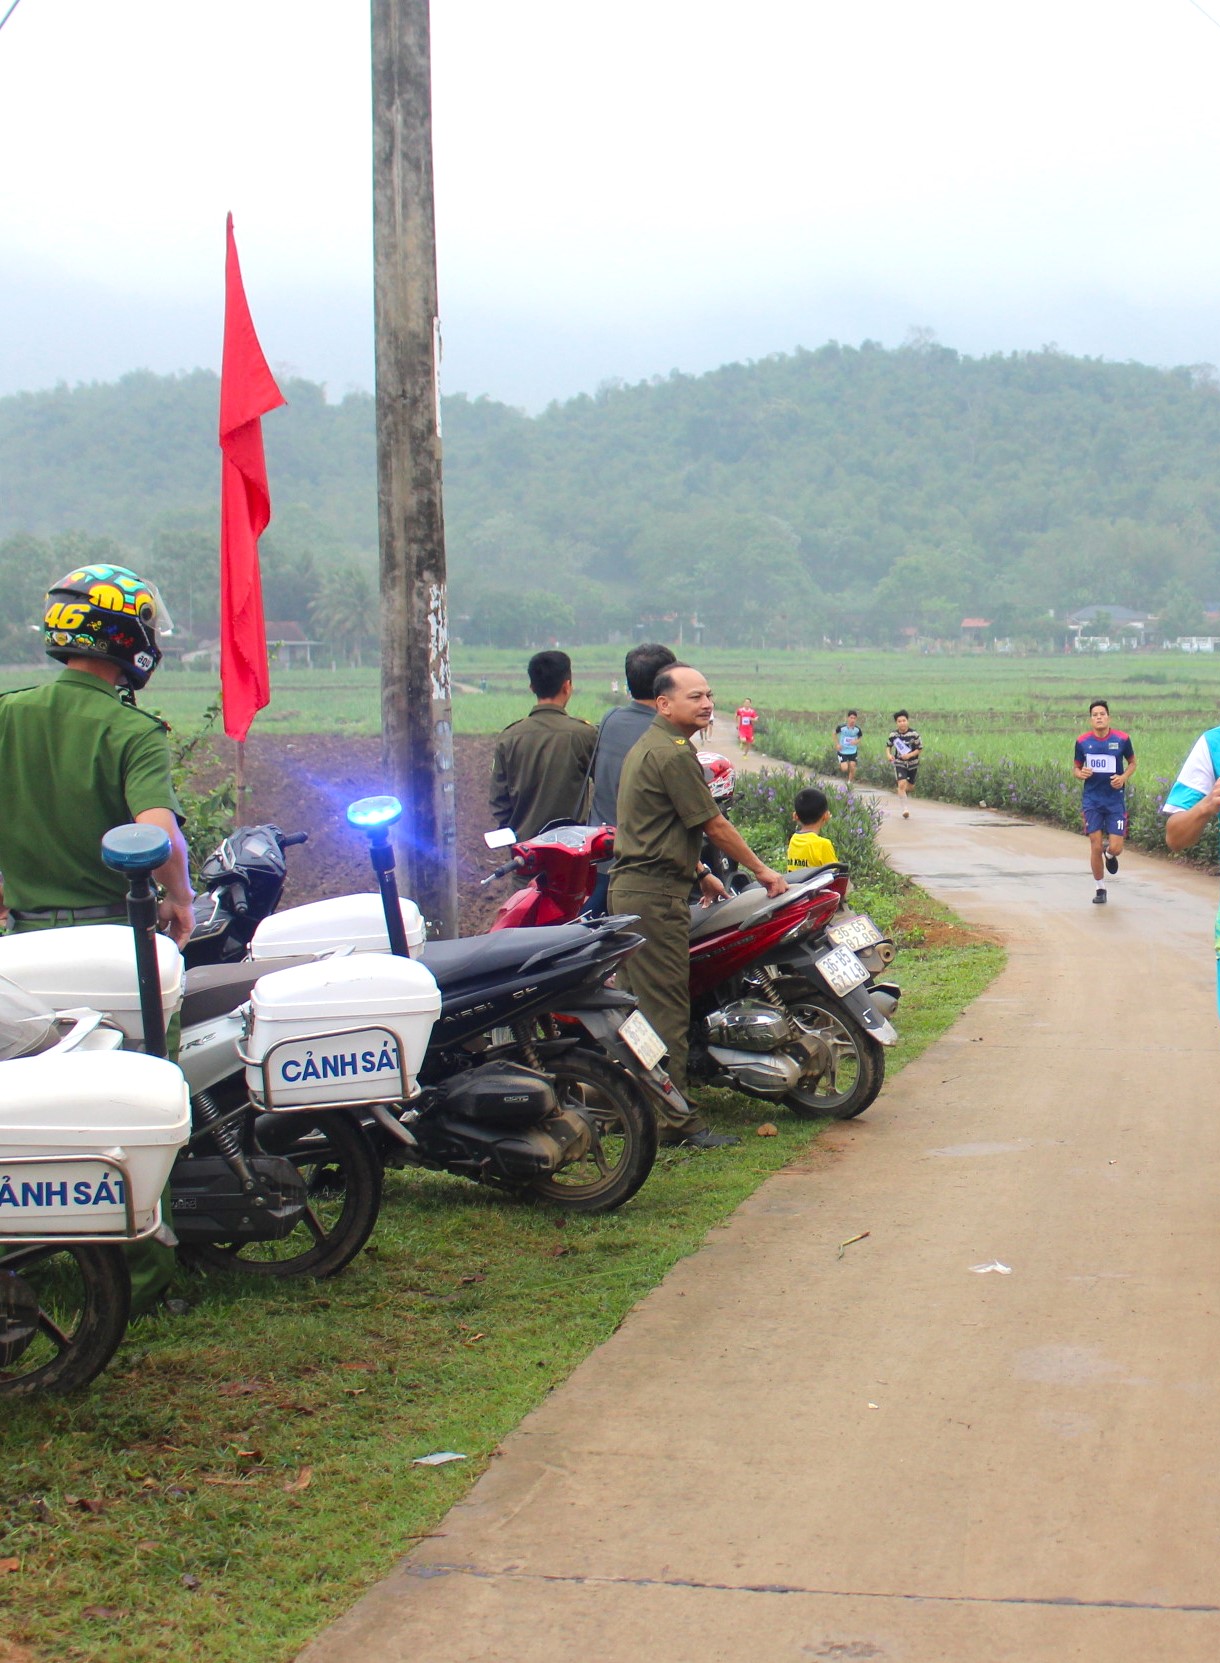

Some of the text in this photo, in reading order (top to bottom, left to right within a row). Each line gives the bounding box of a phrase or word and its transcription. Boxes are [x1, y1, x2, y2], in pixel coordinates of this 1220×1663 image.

[44, 603, 91, 629] 46
[1090, 759, 1107, 768] 060
[1117, 819, 1124, 830] 11
[834, 920, 867, 939] 36-G5
[845, 930, 879, 950] 82.86
[823, 949, 852, 975] 36-B5
[281, 1051, 358, 1083] CẢNH
[0, 1175, 68, 1207] ẢNH
